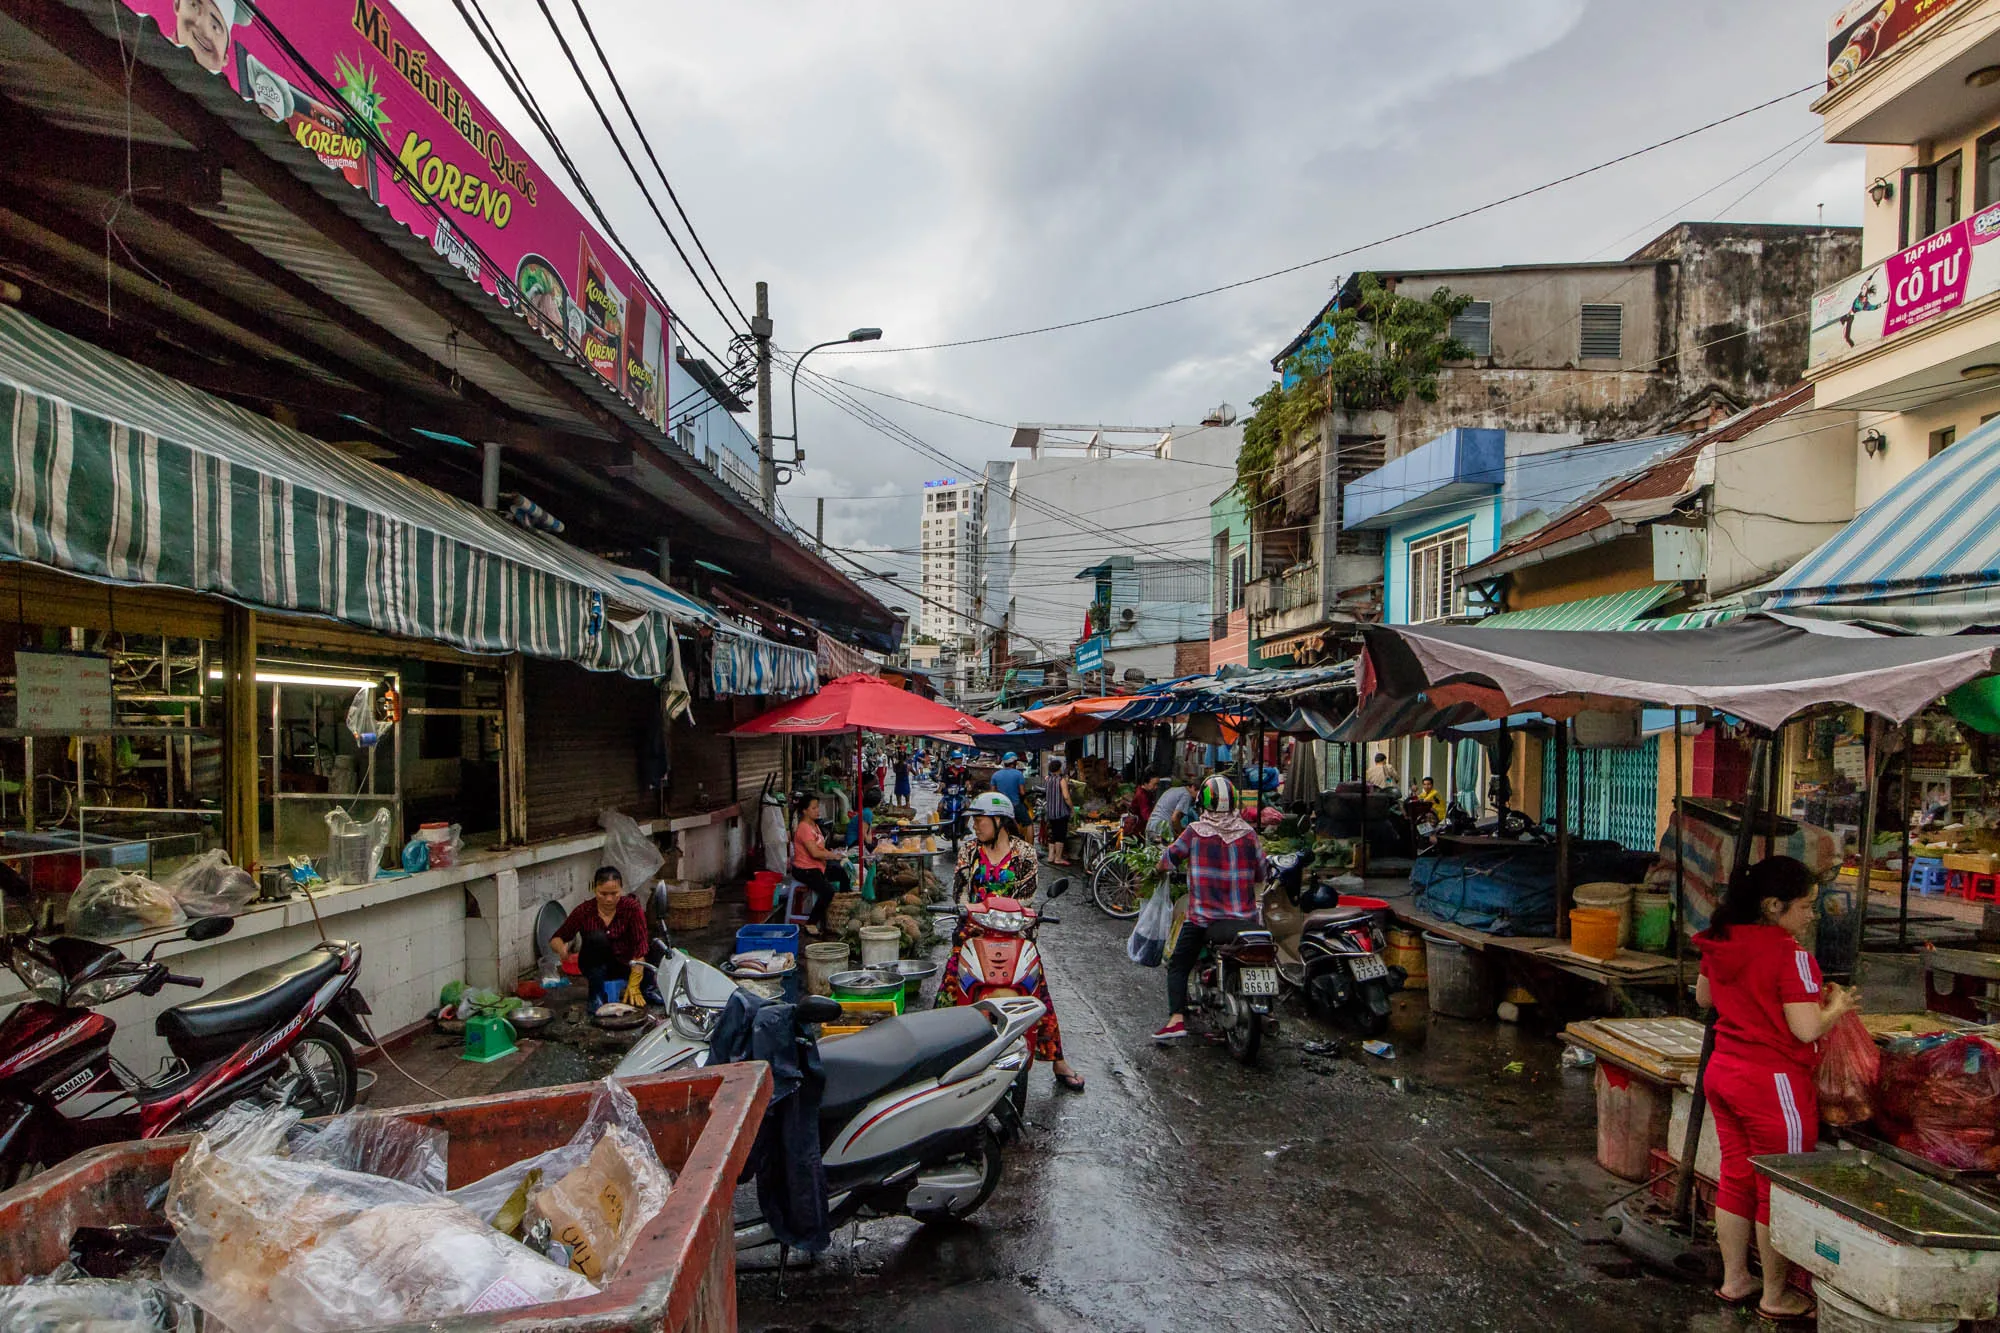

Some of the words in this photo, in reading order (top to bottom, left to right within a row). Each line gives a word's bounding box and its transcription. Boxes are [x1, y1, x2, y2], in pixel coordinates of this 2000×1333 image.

[352, 0, 391, 62] Mì
[441, 77, 487, 158] Hàn
[488, 130, 538, 207] Quốc
[392, 130, 513, 229] KORENO
[1903, 245, 1926, 265] TẠP
[1927, 232, 1952, 254] HÓA
[1895, 266, 1924, 307] CÔ
[1929, 247, 1963, 293] TƯ
[585, 278, 618, 317] KORENO
[584, 336, 616, 362] KORENO
[1245, 969, 1271, 981] 59-T1
[246, 1015, 301, 1065] JUPITER
[53, 1070, 93, 1098] YAMAHA
